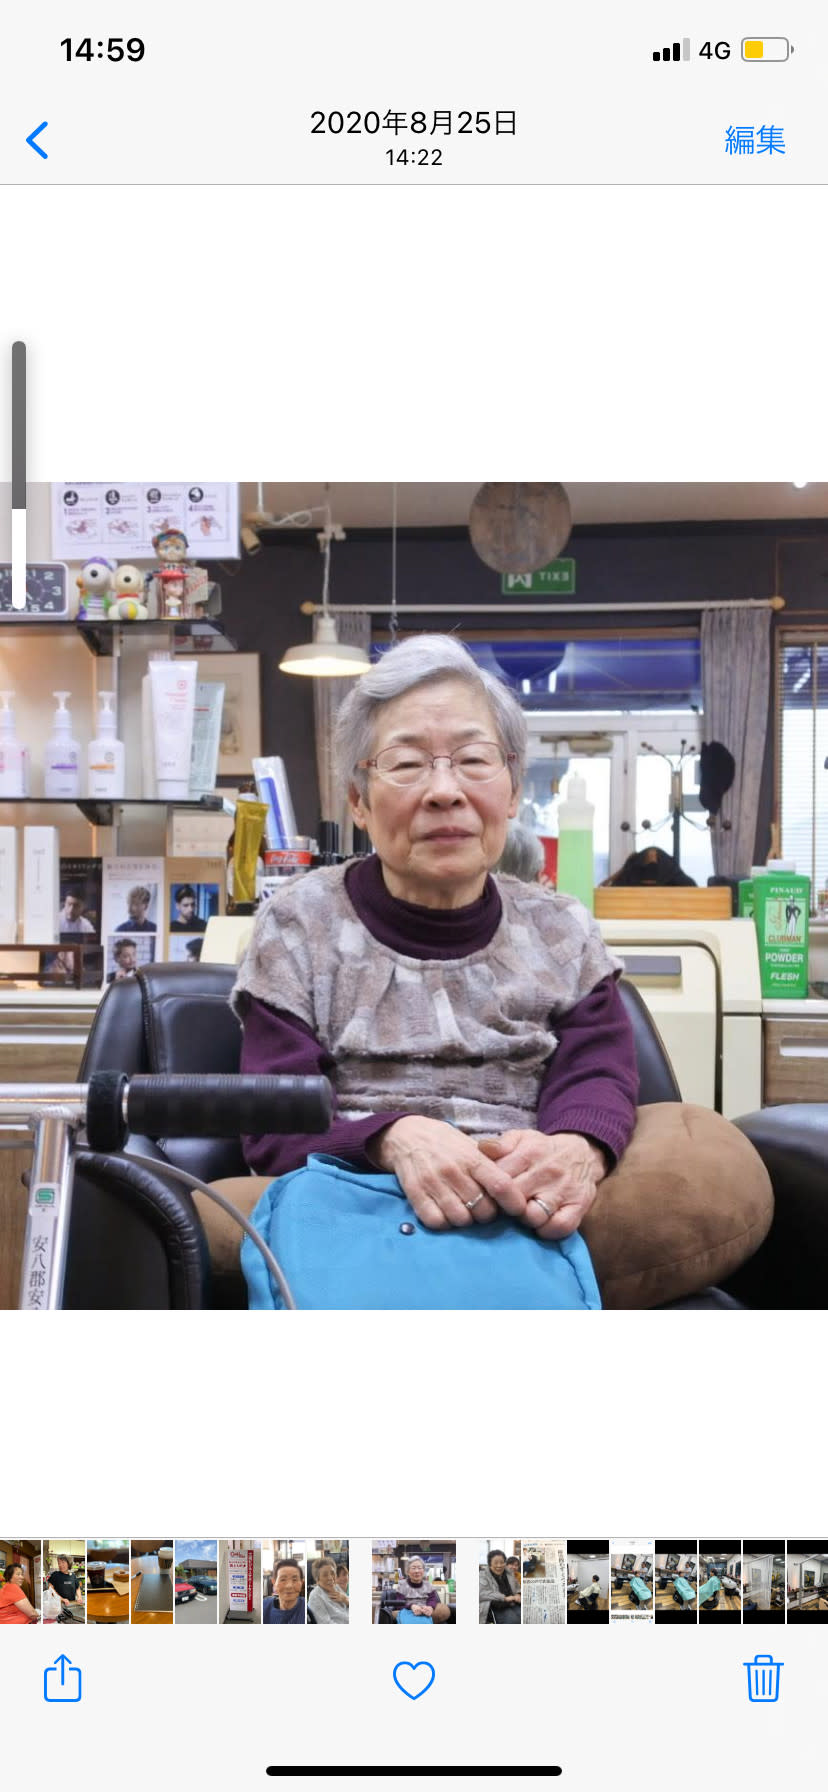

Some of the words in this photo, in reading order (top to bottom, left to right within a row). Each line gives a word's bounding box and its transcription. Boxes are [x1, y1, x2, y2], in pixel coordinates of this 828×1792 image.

[43, 571, 55, 581] 2
[51, 585, 62, 596] 3
[30, 604, 40, 612] 5
[43, 601, 55, 609] 4
[770, 887, 803, 895] PINAUD
[768, 936, 801, 944] CLUBMAN
[765, 952, 804, 963] POWDER
[769, 971, 800, 981] FLESH
[28, 1235, 48, 1310] 安八郡安
